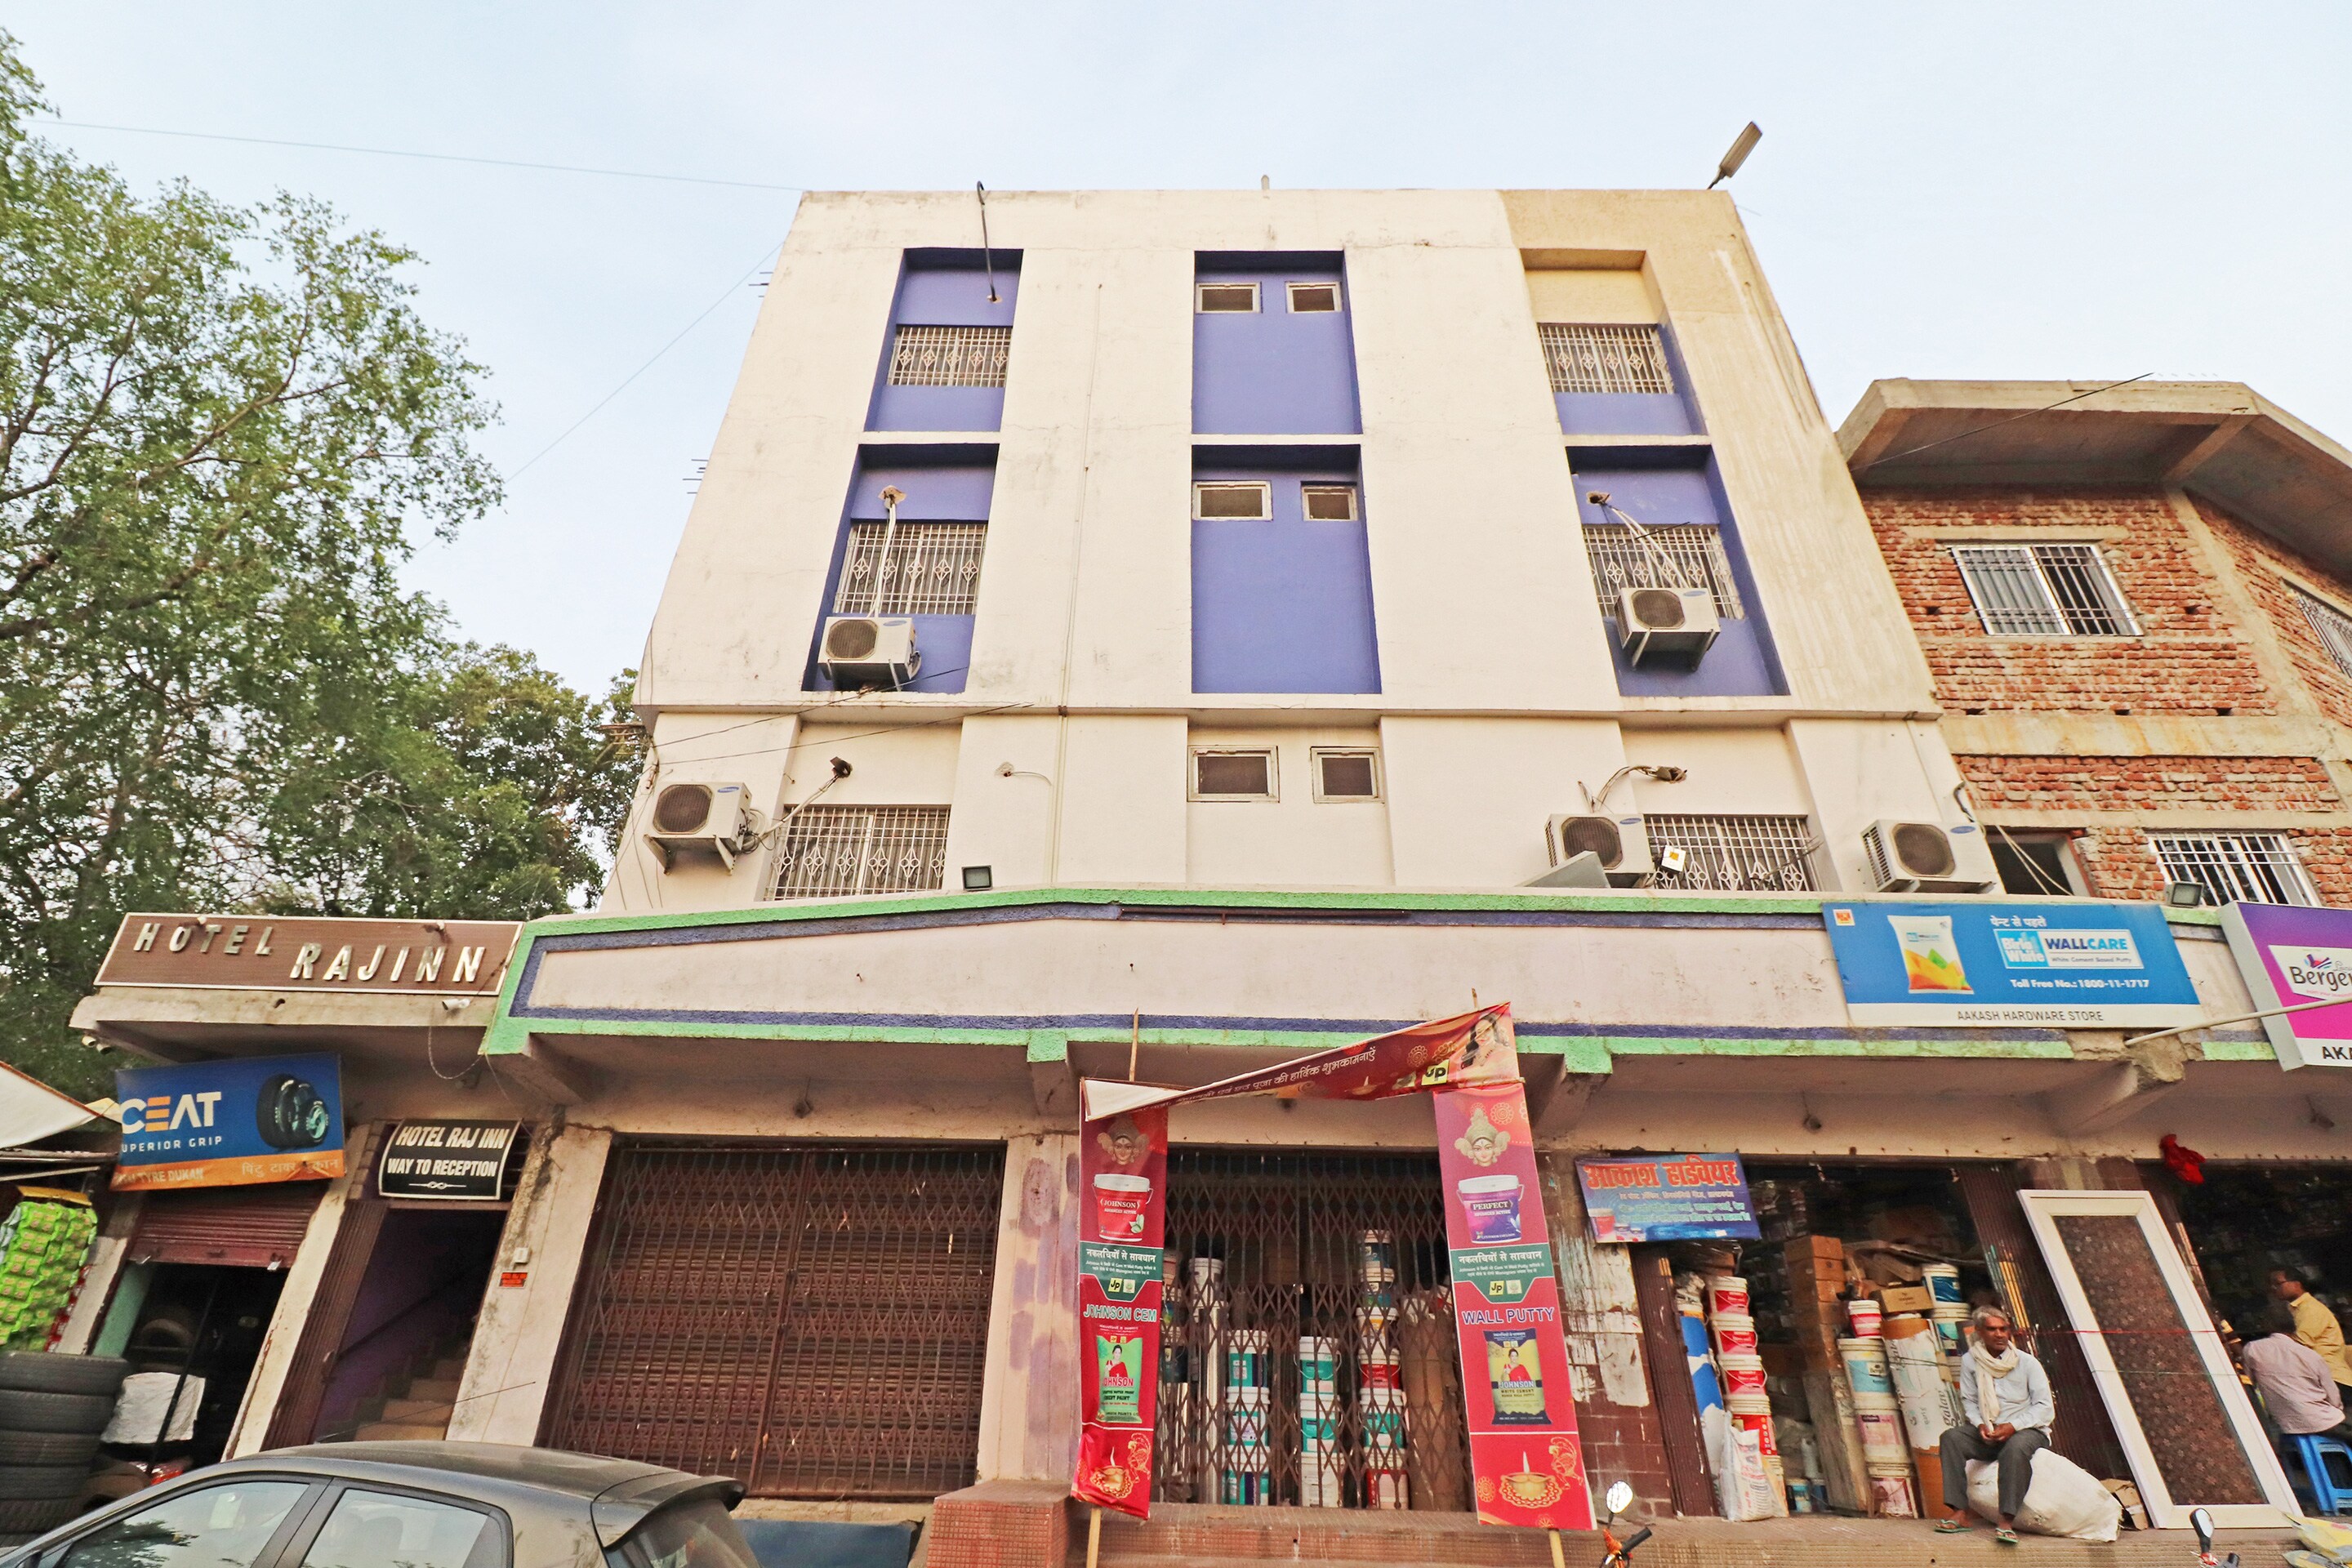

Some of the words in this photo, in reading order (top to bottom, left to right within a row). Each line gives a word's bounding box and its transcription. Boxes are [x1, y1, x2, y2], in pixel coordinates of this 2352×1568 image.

[2011, 915, 2022, 928] से
[2044, 938, 2128, 951] WALLCARE
[133, 922, 273, 956] HOTEL
[289, 942, 486, 982] RAJINN
[2005, 949, 2046, 963] White
[2010, 979, 2030, 988] Toll
[2031, 979, 2054, 988] Free
[2078, 979, 2149, 988] 1800-11-1717
[1958, 1010, 2001, 1021] AAKASH
[2003, 1010, 2065, 1021] HARDWARE
[2068, 1011, 2104, 1022] STORE
[2322, 1045, 2352, 1060] AK
[1274, 1071, 1288, 1085] की
[1290, 1065, 1321, 1083] हार्दिक
[121, 1091, 222, 1134] CEAT
[189, 1135, 223, 1148] GRIP
[395, 1125, 446, 1147] HOTEL
[445, 1127, 481, 1148] RAJ
[478, 1129, 510, 1149] INN
[387, 1158, 414, 1174] WAY
[415, 1158, 431, 1174] TO
[432, 1160, 498, 1177] RECEPTION
[1583, 1163, 1661, 1189] आकाश
[1104, 1200, 1137, 1209] JOHNSON
[1472, 1201, 1508, 1210] PERFECT
[1121, 1251, 1128, 1261] से
[1129, 1254, 1156, 1263] सावधान
[1499, 1251, 1507, 1262] से
[1510, 1250, 1543, 1261] सावधान
[1084, 1303, 1132, 1321] JOHNSON
[1134, 1308, 1157, 1322] CEM
[1462, 1310, 1504, 1325] WALL
[1506, 1307, 1555, 1323] PUTTY
[1499, 1380, 1535, 1389] JOHNSON
